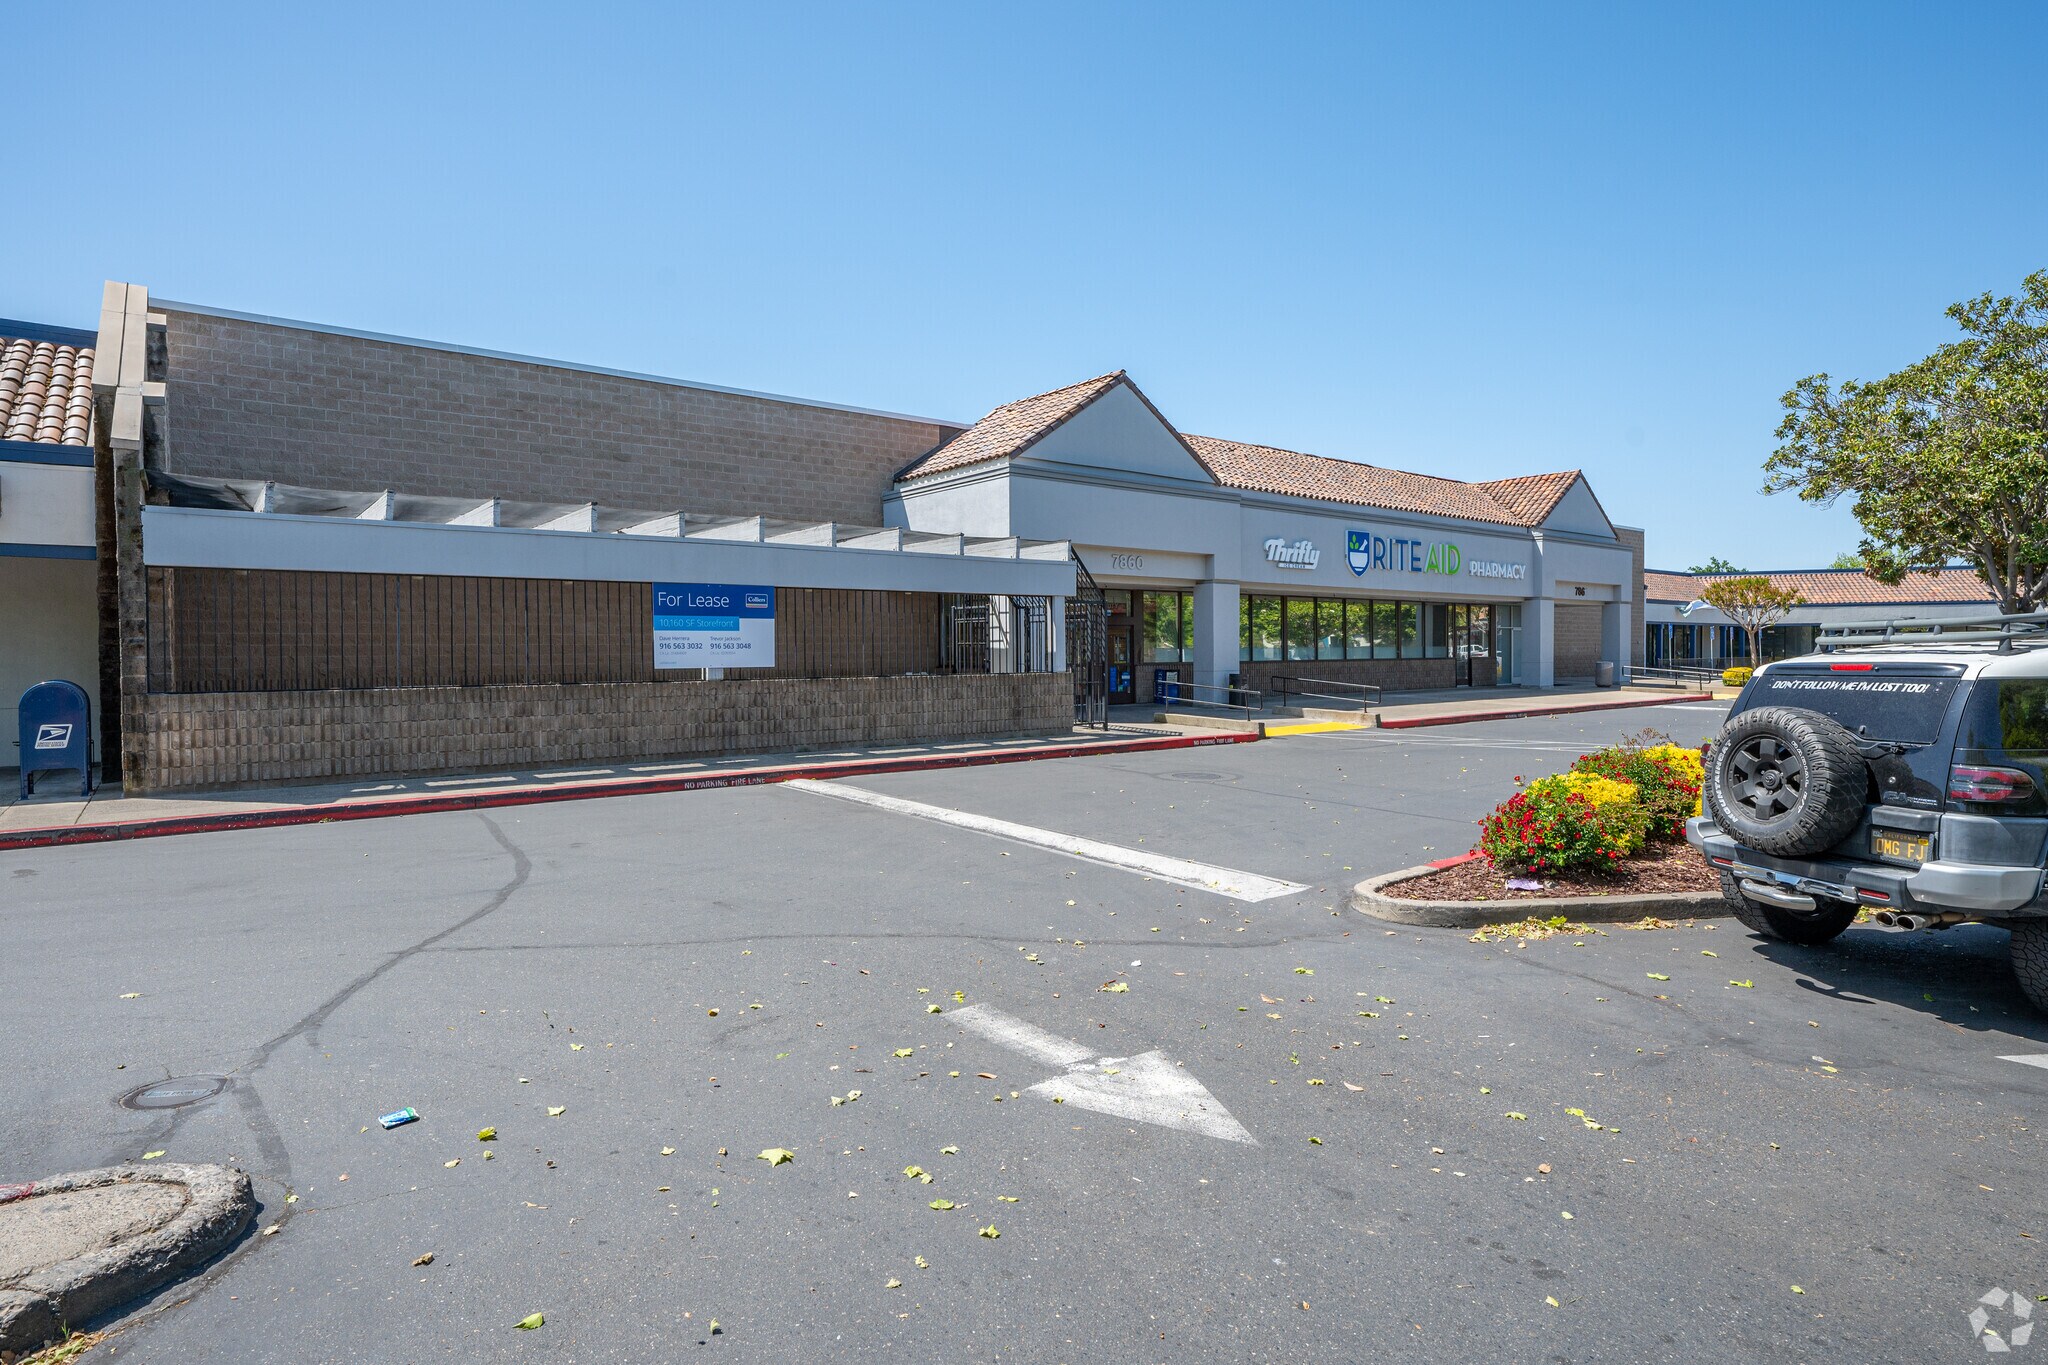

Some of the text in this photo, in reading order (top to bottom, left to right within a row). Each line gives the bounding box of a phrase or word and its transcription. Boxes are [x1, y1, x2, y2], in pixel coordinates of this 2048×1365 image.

[1263, 538, 1320, 569] Thrifty
[1372, 537, 1461, 575] RITE AID
[1111, 554, 1144, 570] 7860
[1469, 561, 1526, 579] PHARMACY
[658, 591, 730, 608] For Lease
[686, 619, 695, 627] SF
[697, 618, 734, 628] Storefront
[1771, 680, 1802, 689] DON'T
[1798, 681, 1844, 690] FOLLOW
[1839, 681, 1859, 691] ME
[1871, 682, 1903, 692] LOST
[1901, 683, 1931, 693] TOO!
[696, 780, 728, 788] PARKING
[731, 778, 746, 786] FIRE
[1884, 832, 1917, 841] CALIFORNIA
[1876, 838, 1924, 860] OMG FJ
